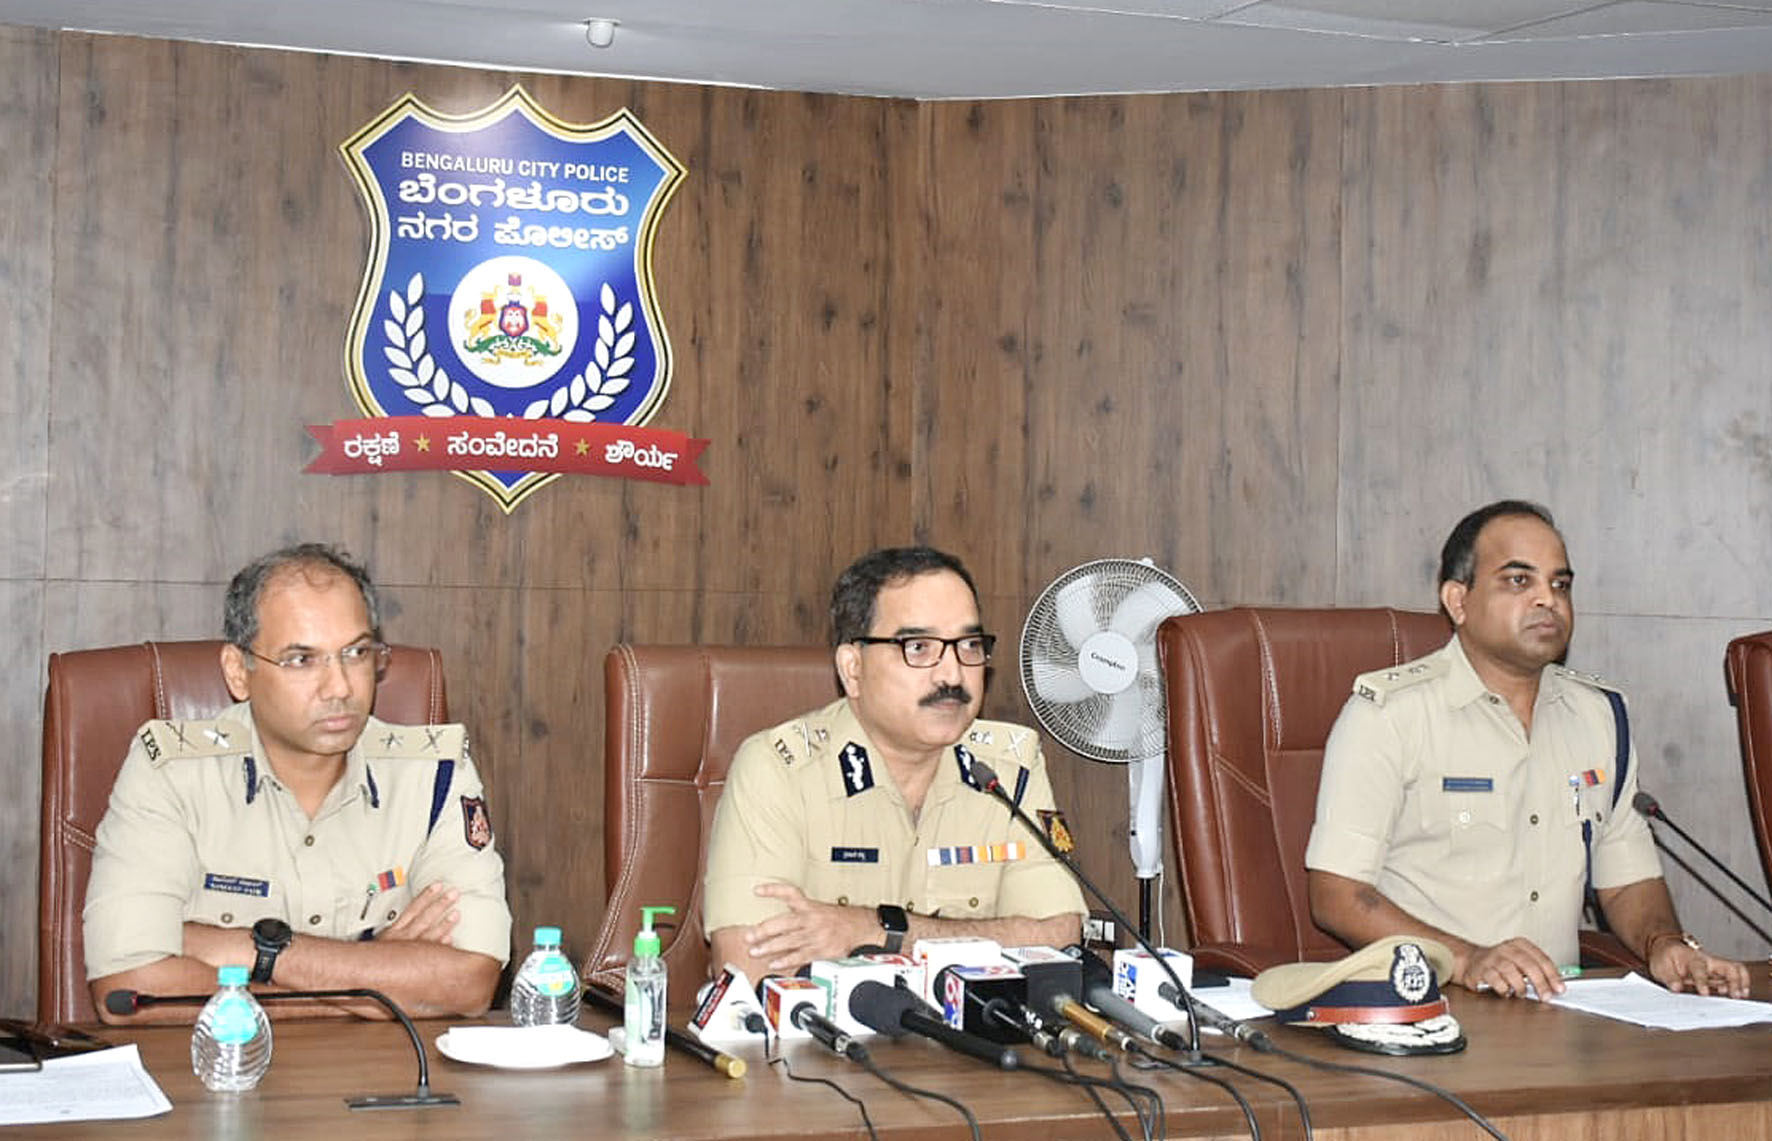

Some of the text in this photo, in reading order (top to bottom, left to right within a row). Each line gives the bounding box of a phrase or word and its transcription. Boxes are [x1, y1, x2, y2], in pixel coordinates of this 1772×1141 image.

[401, 151, 629, 183] BENGALURU CITY POLICE
[399, 173, 629, 216] ಬೆಂಗಳೂರು
[398, 211, 479, 242] ನಗರ
[344, 431, 678, 470] ರಕ್ಷಣೆ ಸಂವೇದನೆ ಶೌರ್ಯ
